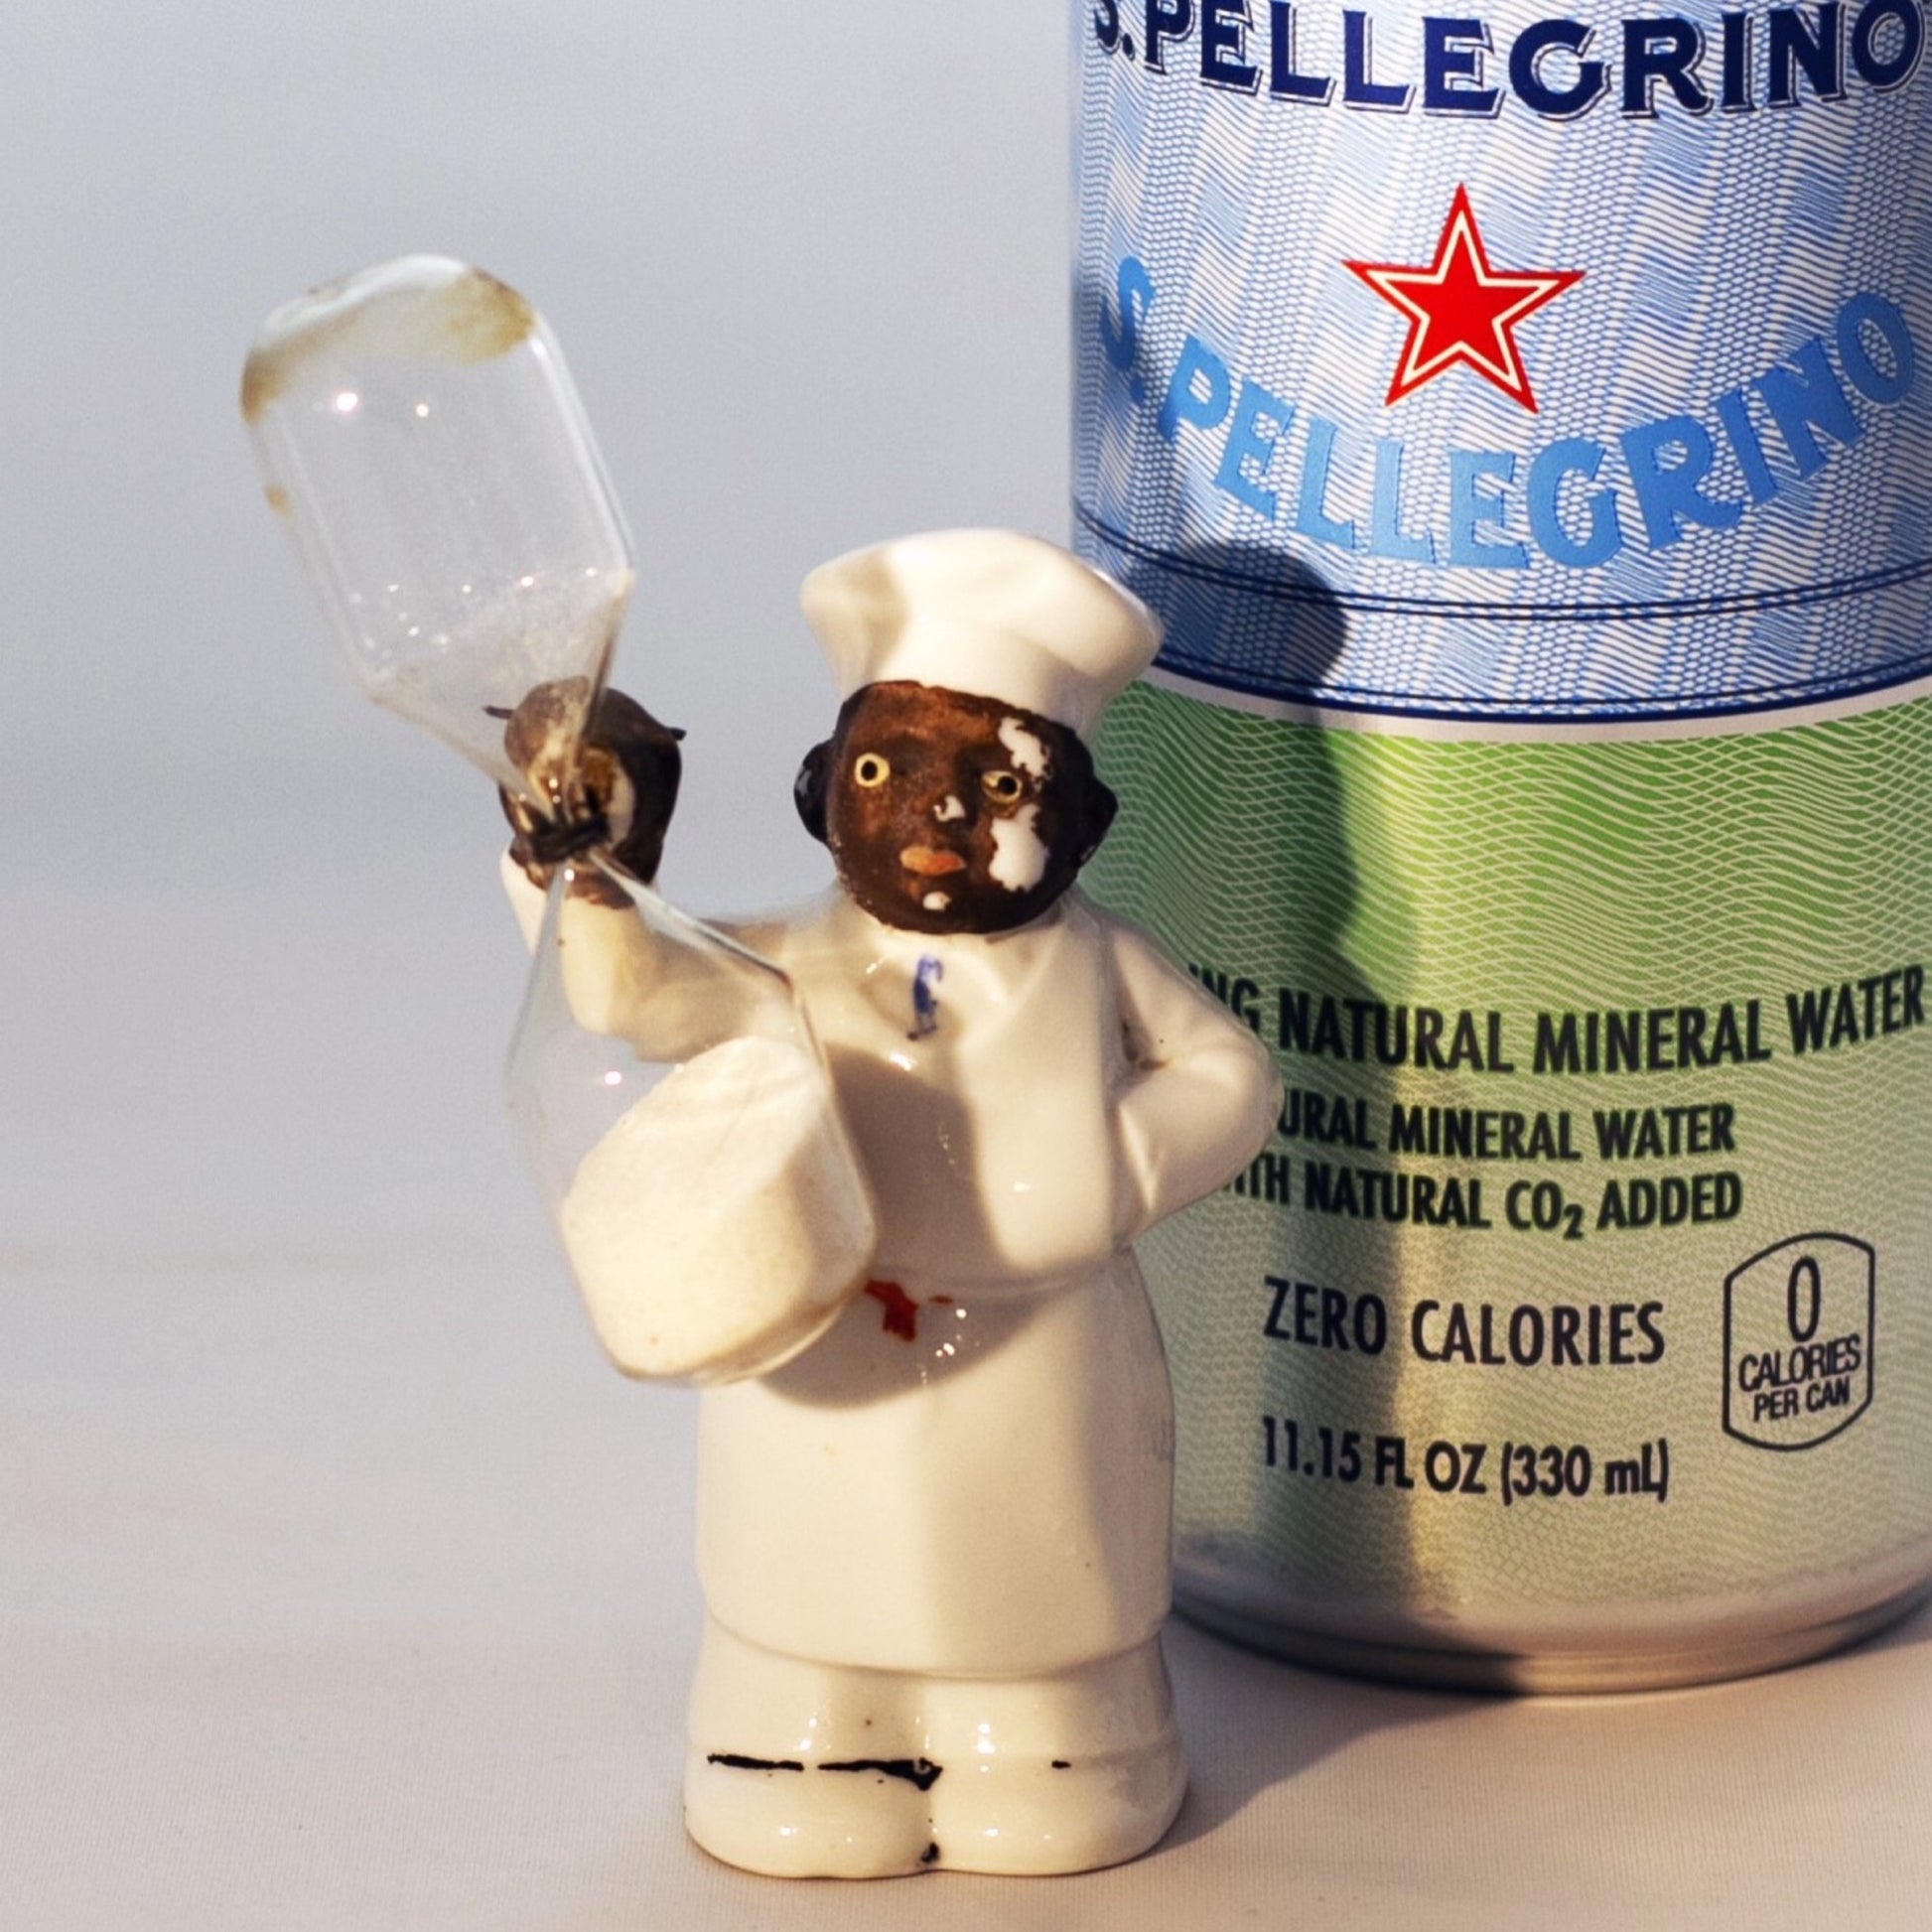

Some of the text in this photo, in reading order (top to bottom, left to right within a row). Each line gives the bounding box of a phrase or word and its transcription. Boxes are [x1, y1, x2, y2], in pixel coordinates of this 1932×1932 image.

[1158, 291, 1915, 570] PELLEGRINO
[1278, 987, 1515, 1074] NATURAL
[1533, 999, 1772, 1074] MINERAL
[1784, 964, 1925, 1054] WATER
[1277, 1089, 1735, 1161] URAL MINERAL WATER
[1303, 1159, 1492, 1229] NATURAL
[1596, 1172, 1742, 1230] ADDED
[1263, 1276, 1665, 1367] ZERO CALORIES
[1787, 1256, 1821, 1342] 0
[1738, 1333, 1862, 1392] CALORIES
[1753, 1376, 1850, 1423] PER CAN
[1263, 1415, 1669, 1506] 11.15 FL OZ (330 mL)
